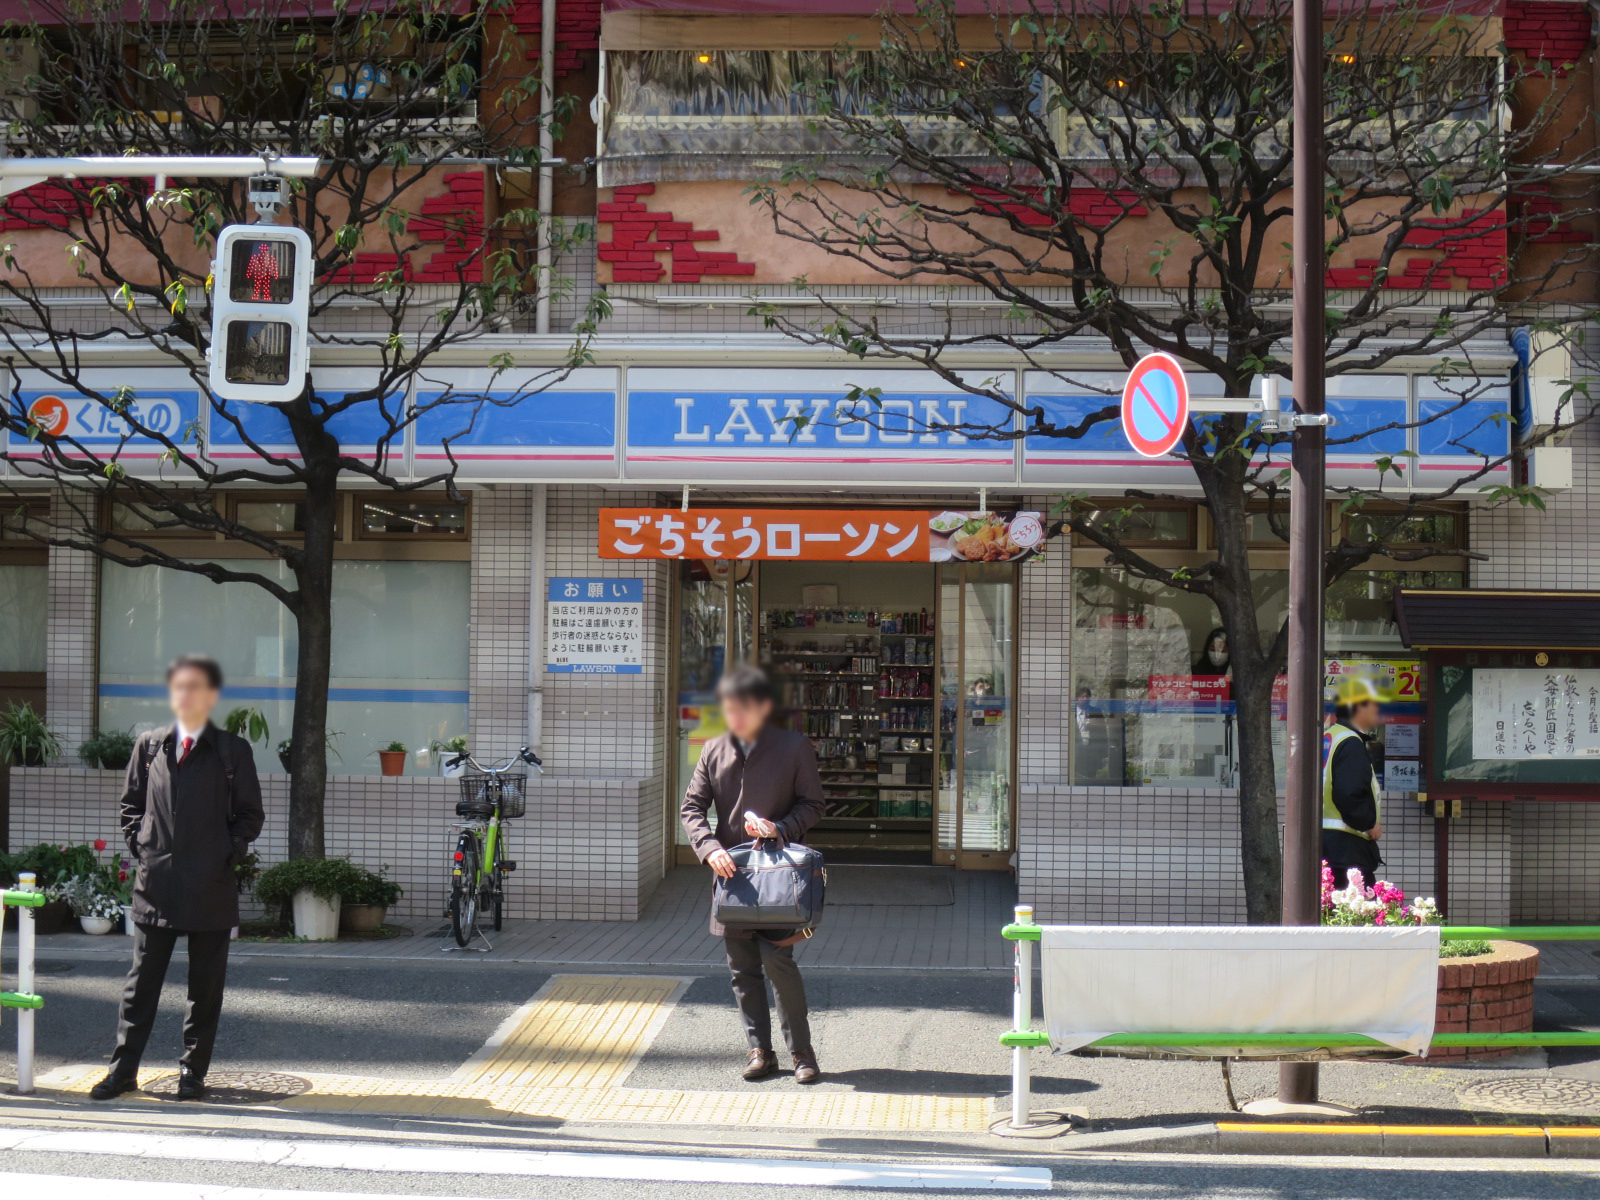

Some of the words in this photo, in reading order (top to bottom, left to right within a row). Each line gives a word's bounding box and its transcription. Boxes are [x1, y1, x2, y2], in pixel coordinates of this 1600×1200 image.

[674, 398, 969, 445] LAWSON
[613, 513, 919, 559] ごちそうローソン
[564, 582, 628, 598] お願い
[552, 606, 638, 615] 当店ご利用以外の方の
[552, 631, 638, 640] 歩行者の迷惑とならない
[573, 665, 616, 673] LAWSON
[1495, 720, 1506, 755] 日蓮宗
